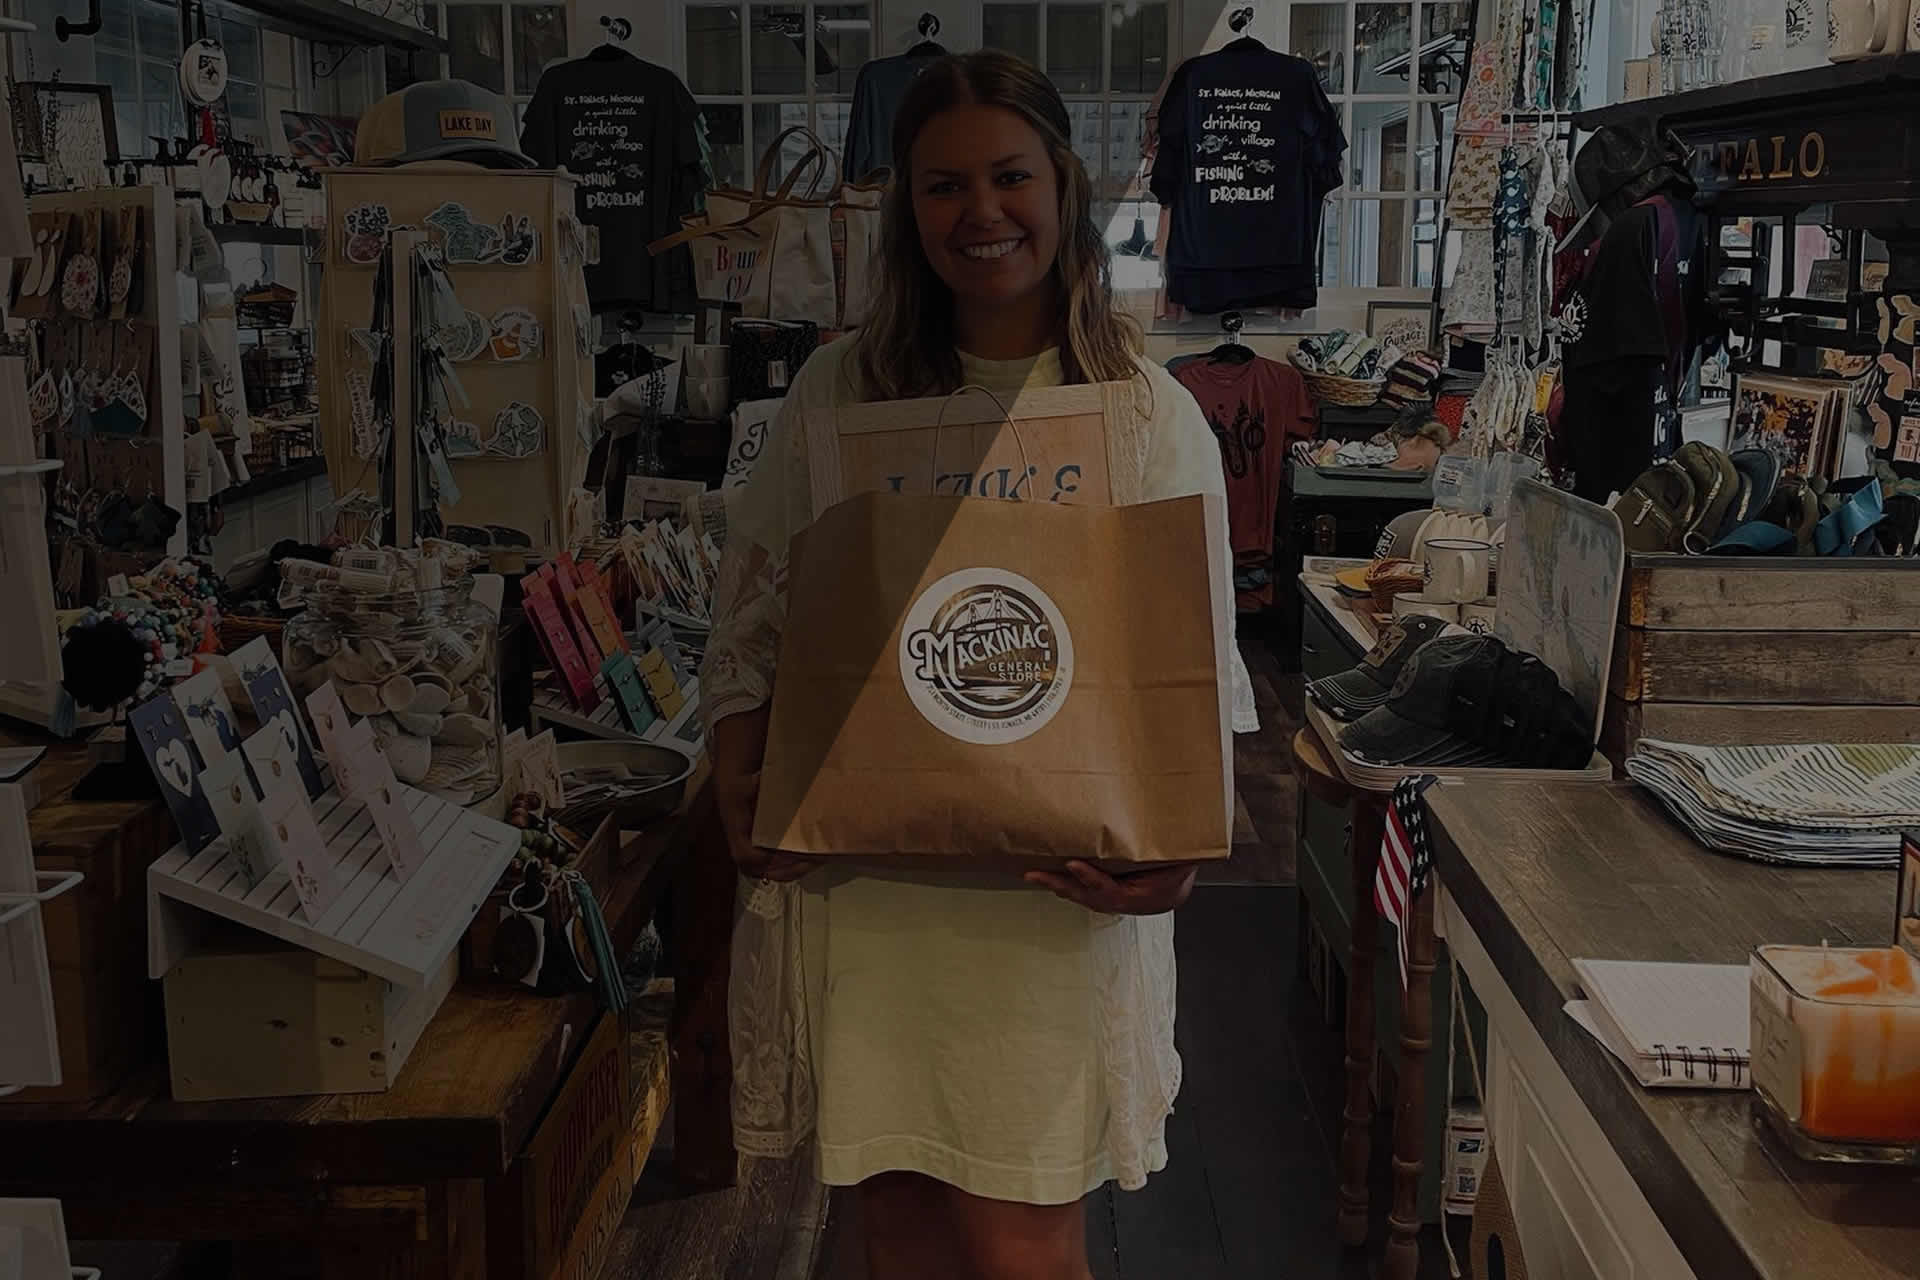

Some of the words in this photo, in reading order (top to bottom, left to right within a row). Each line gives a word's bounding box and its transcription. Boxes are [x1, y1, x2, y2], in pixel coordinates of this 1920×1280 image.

[1245, 88, 1280, 100] MICHIGAN
[445, 117, 472, 131] LAKE
[475, 117, 493, 133] DAY
[572, 119, 629, 138] drinking
[1202, 112, 1261, 133] drinking
[1240, 133, 1276, 148] village
[1195, 164, 1245, 183] FISHING
[585, 190, 645, 209] PROBLEM!
[1209, 183, 1275, 204] PROBLEM!
[908, 623, 1051, 688] MACKINAC
[988, 661, 1051, 672] GENERAL
[998, 671, 1041, 682] STORE
